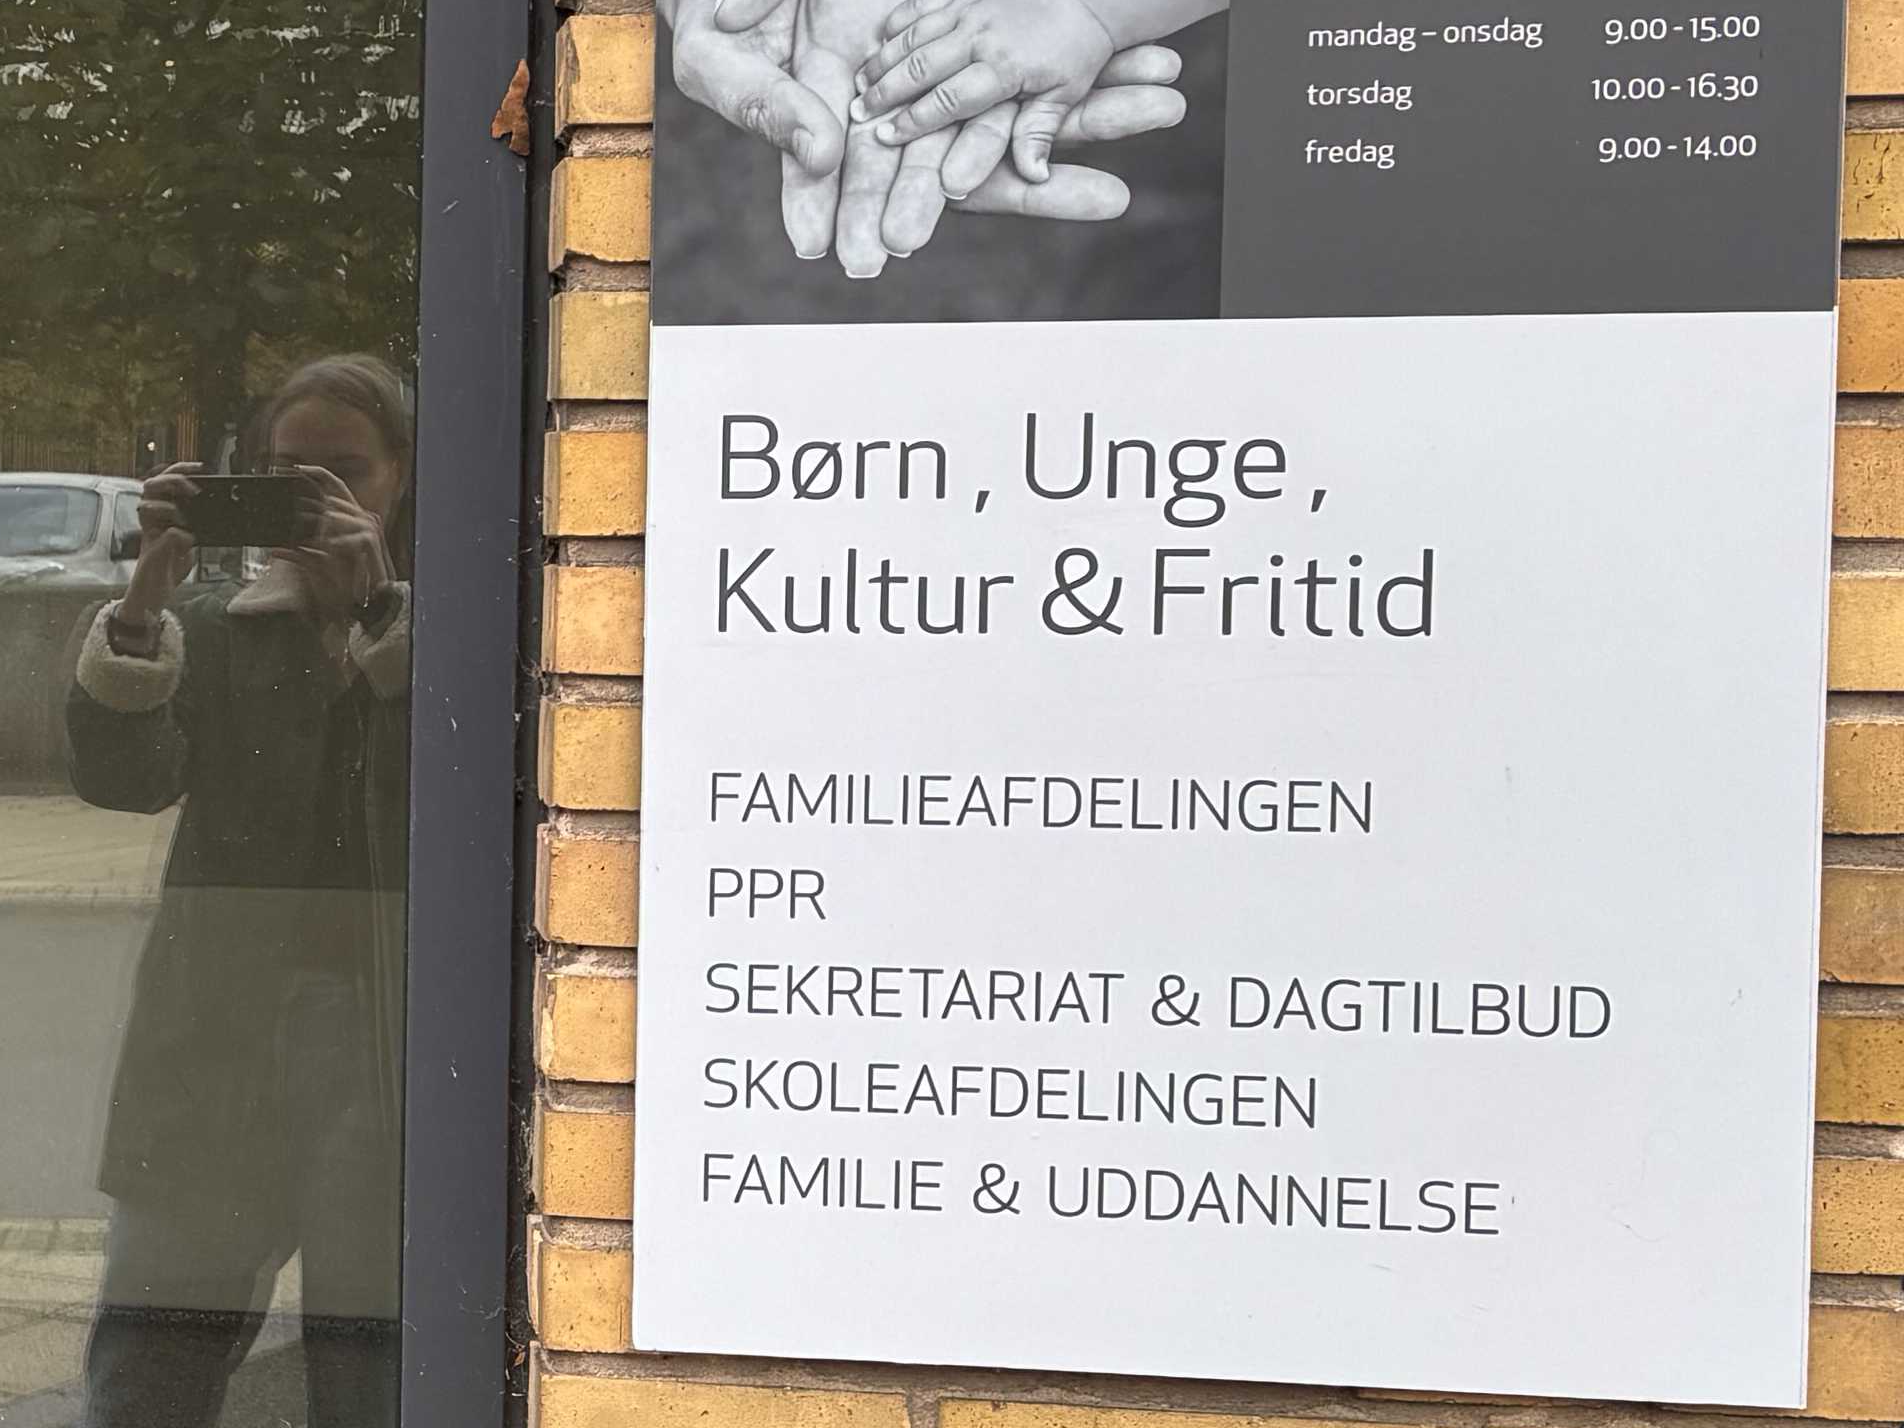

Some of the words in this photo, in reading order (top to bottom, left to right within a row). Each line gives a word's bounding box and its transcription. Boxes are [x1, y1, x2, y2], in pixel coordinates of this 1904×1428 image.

[1306, 79, 1414, 112] torsdag
[1304, 137, 1396, 170] fredag
[717, 547, 1016, 636] Kultur
[1040, 546, 1125, 637] &
[1152, 547, 1435, 639] Fritid
[710, 771, 1373, 835] FAMILIEAFDELINGEN
[708, 867, 827, 921] PPR
[704, 962, 1126, 1025] SEKRETARIAT
[1150, 974, 1202, 1028] &
[1229, 976, 1612, 1040] DAGTILBUD
[702, 1058, 1317, 1129] SKOLEAFDELINGEN
[702, 1153, 945, 1213] FAMILIE
[971, 1162, 1022, 1216] &
[1048, 1165, 1501, 1236] UDDANNELSE
